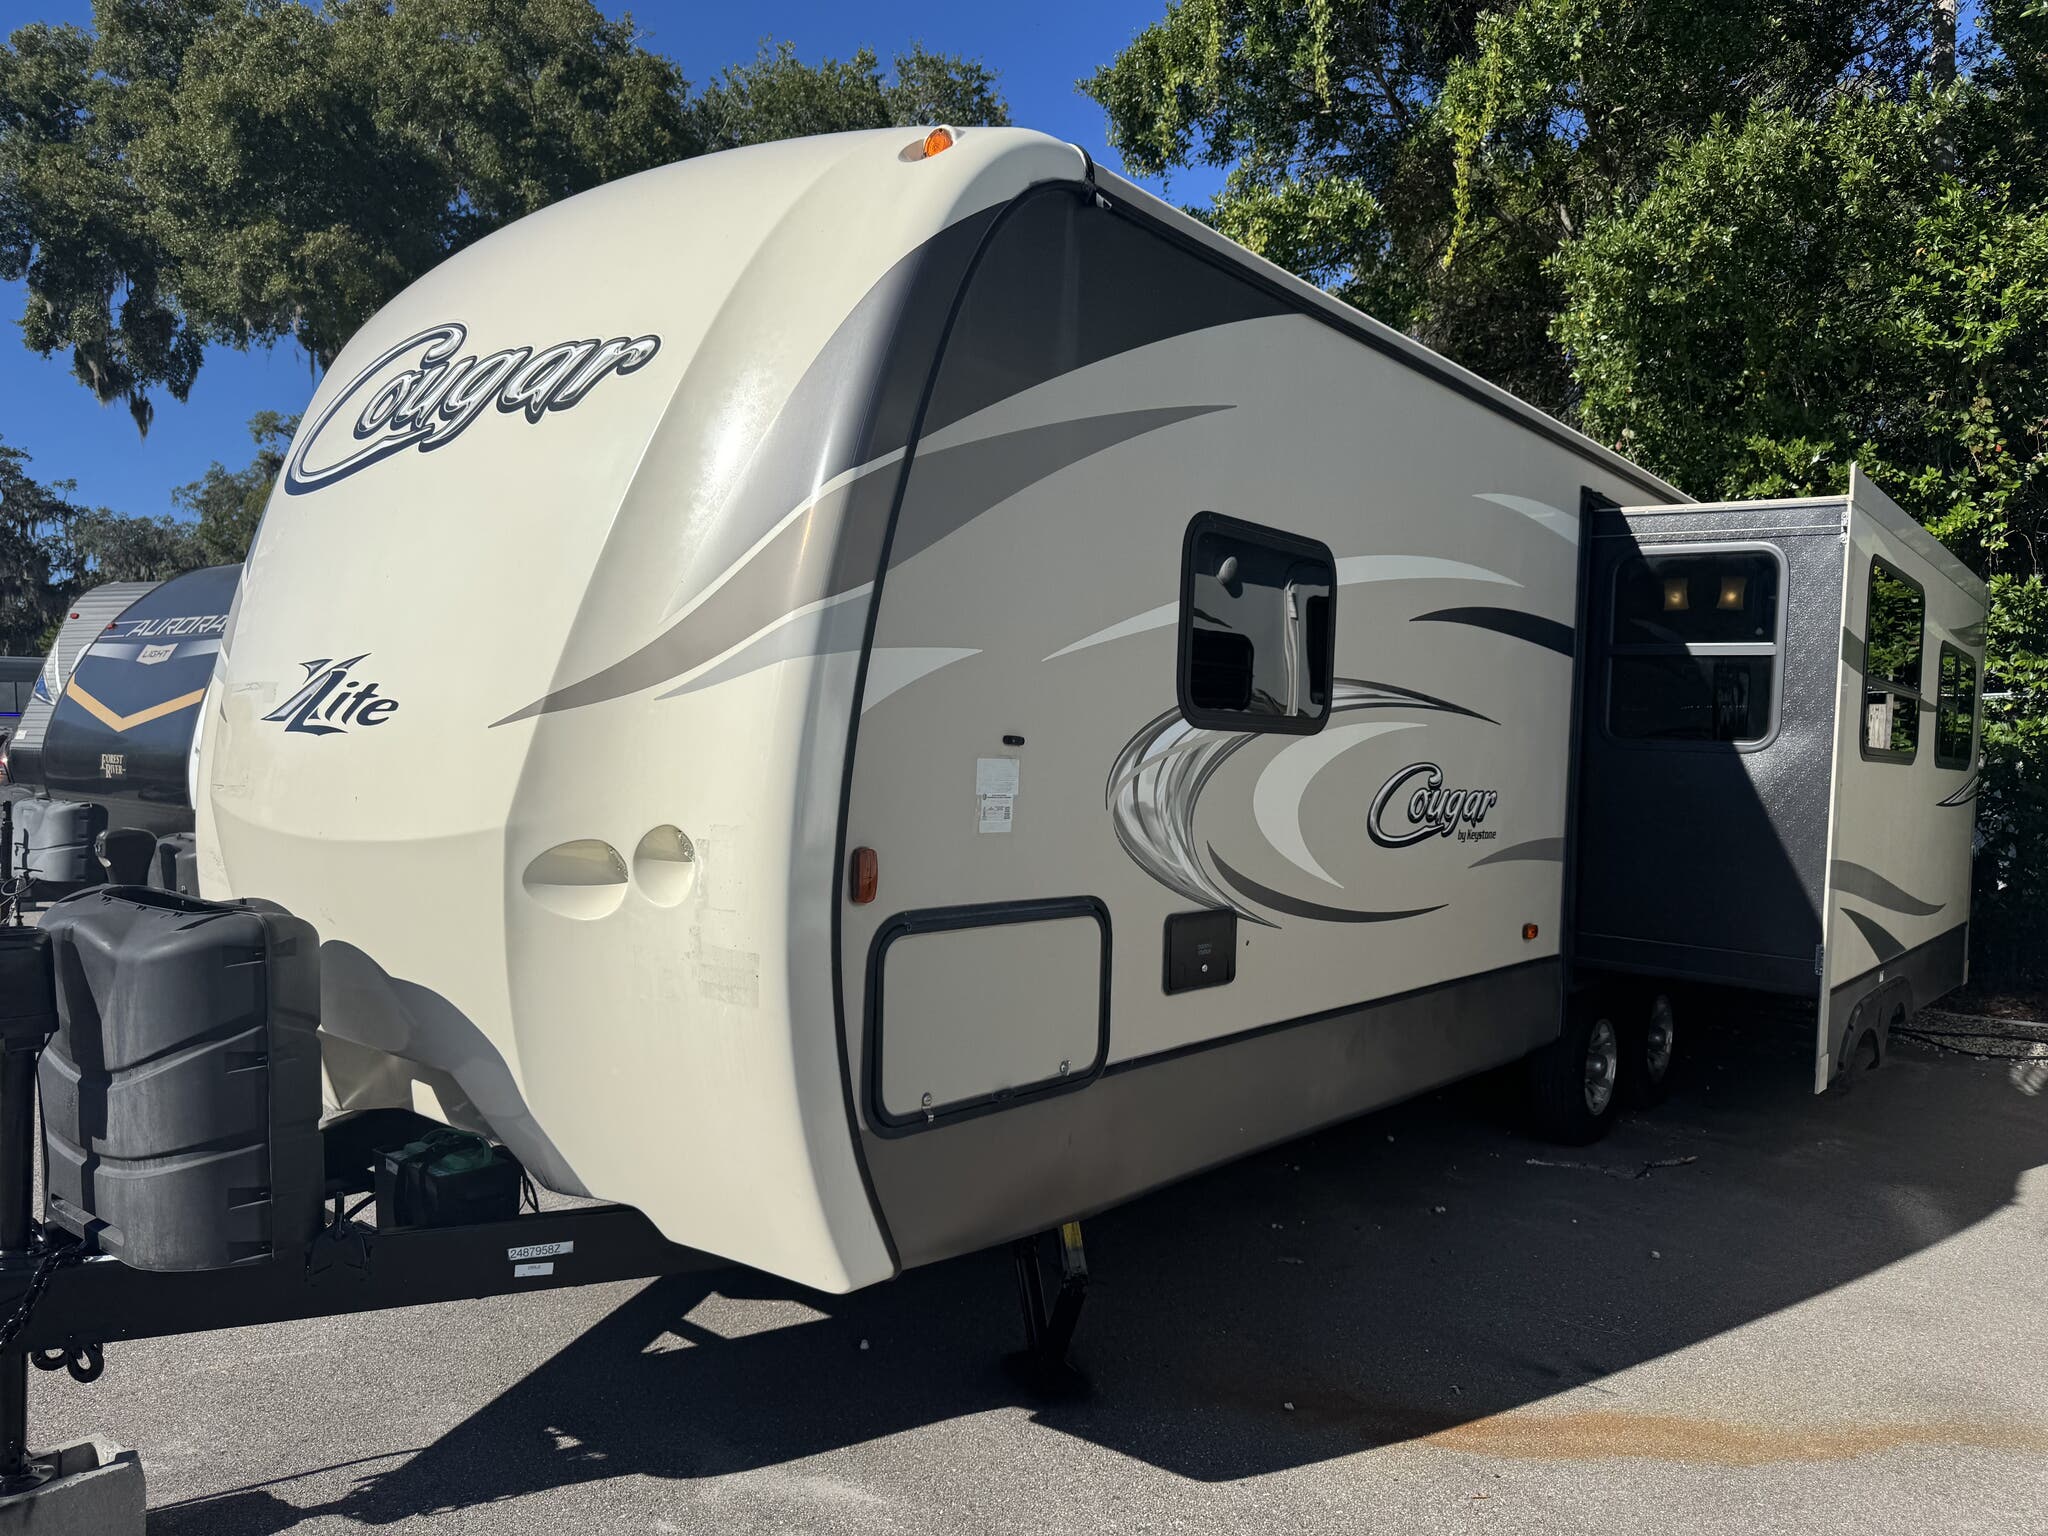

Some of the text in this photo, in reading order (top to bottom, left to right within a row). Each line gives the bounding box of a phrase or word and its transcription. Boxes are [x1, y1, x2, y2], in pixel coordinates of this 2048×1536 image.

[284, 322, 661, 496] Cougar
[125, 615, 229, 637] AURORA
[142, 650, 170, 658] LIGHT
[1367, 762, 1497, 849] Cougar
[1457, 829, 1497, 843] by Keystone
